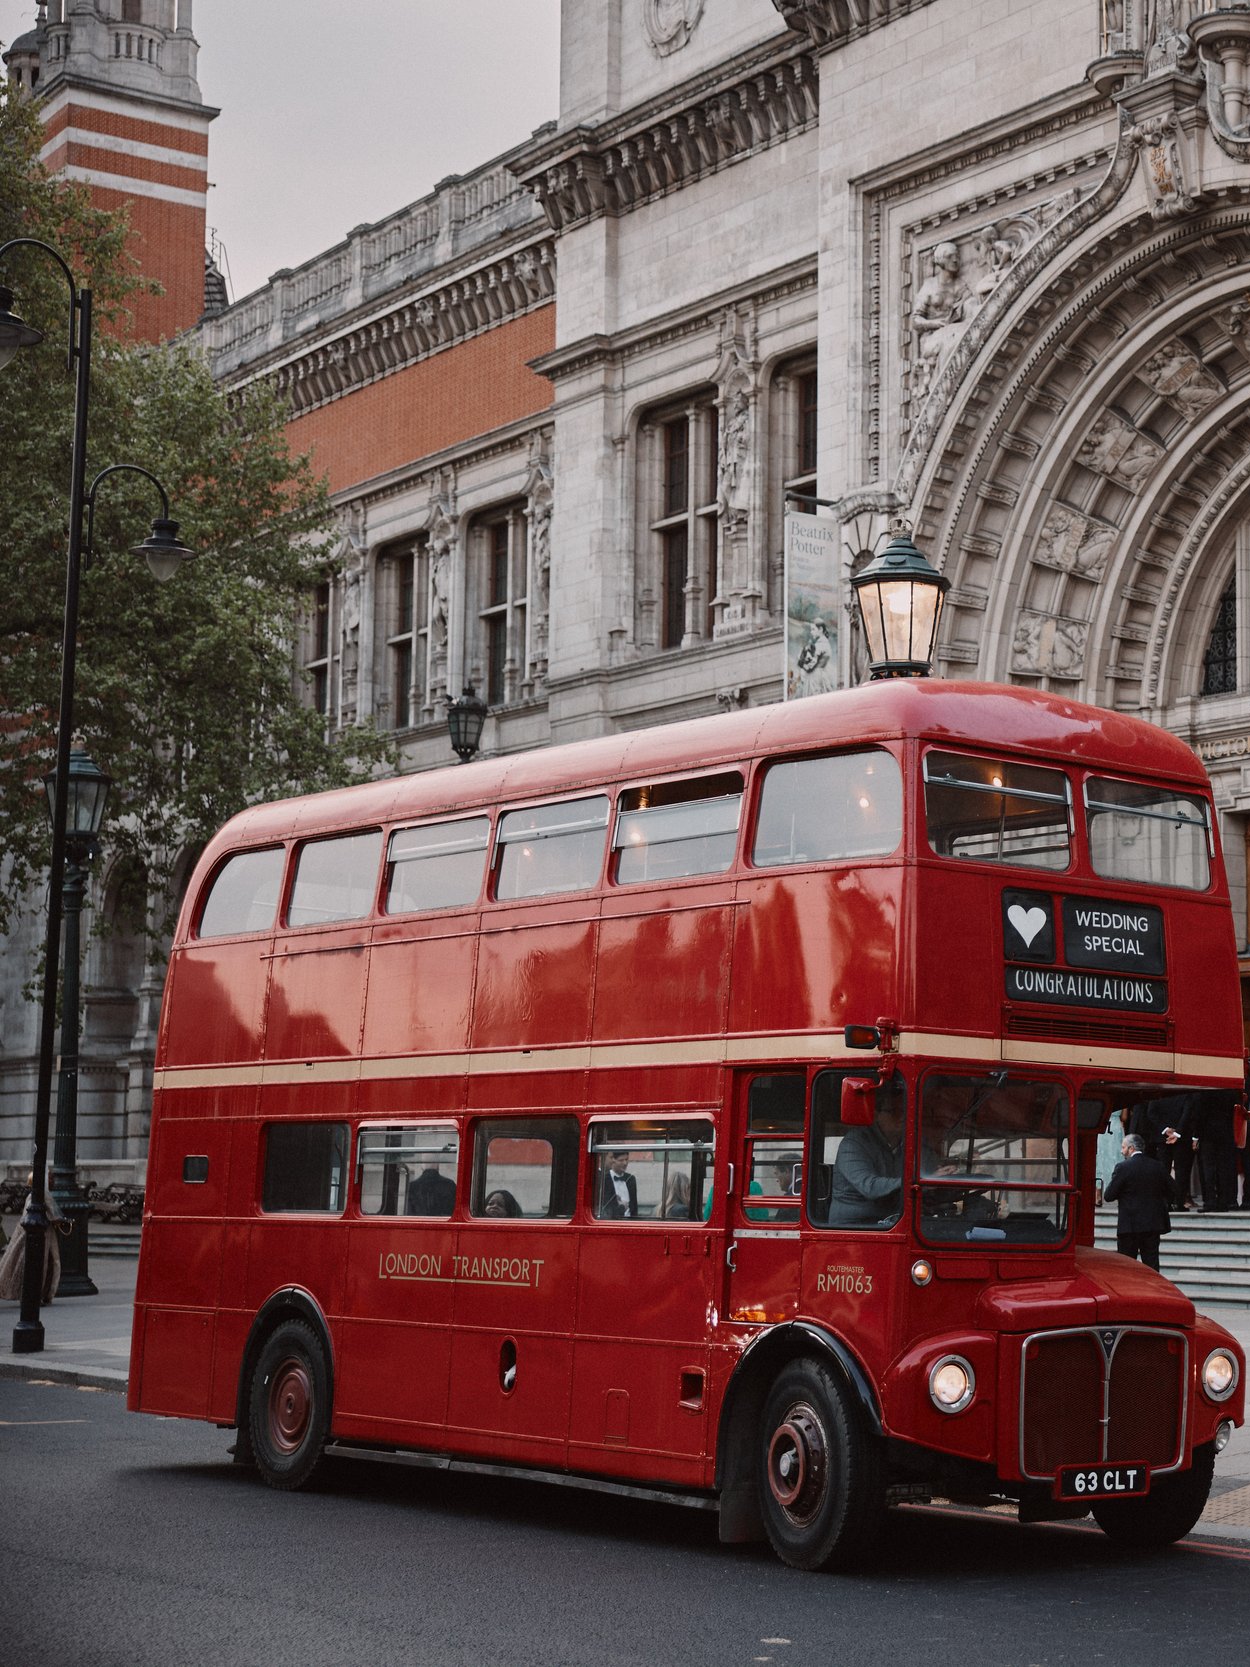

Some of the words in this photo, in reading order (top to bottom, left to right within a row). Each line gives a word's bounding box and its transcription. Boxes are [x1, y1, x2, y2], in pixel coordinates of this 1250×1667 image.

[791, 521, 834, 542] Beatrix
[790, 537, 826, 556] Potter
[1075, 909, 1149, 932] WEDDING
[1084, 935, 1145, 955] SPECIAL
[1015, 969, 1154, 1004] CONGRATULATIONS
[378, 1253, 442, 1279] LONDON
[452, 1255, 545, 1287] TRANSPORT
[826, 1265, 865, 1274] ROUTEMASTER
[817, 1273, 873, 1294] RM1063
[1074, 1471, 1098, 1493] 63
[1103, 1469, 1138, 1491] CLT
